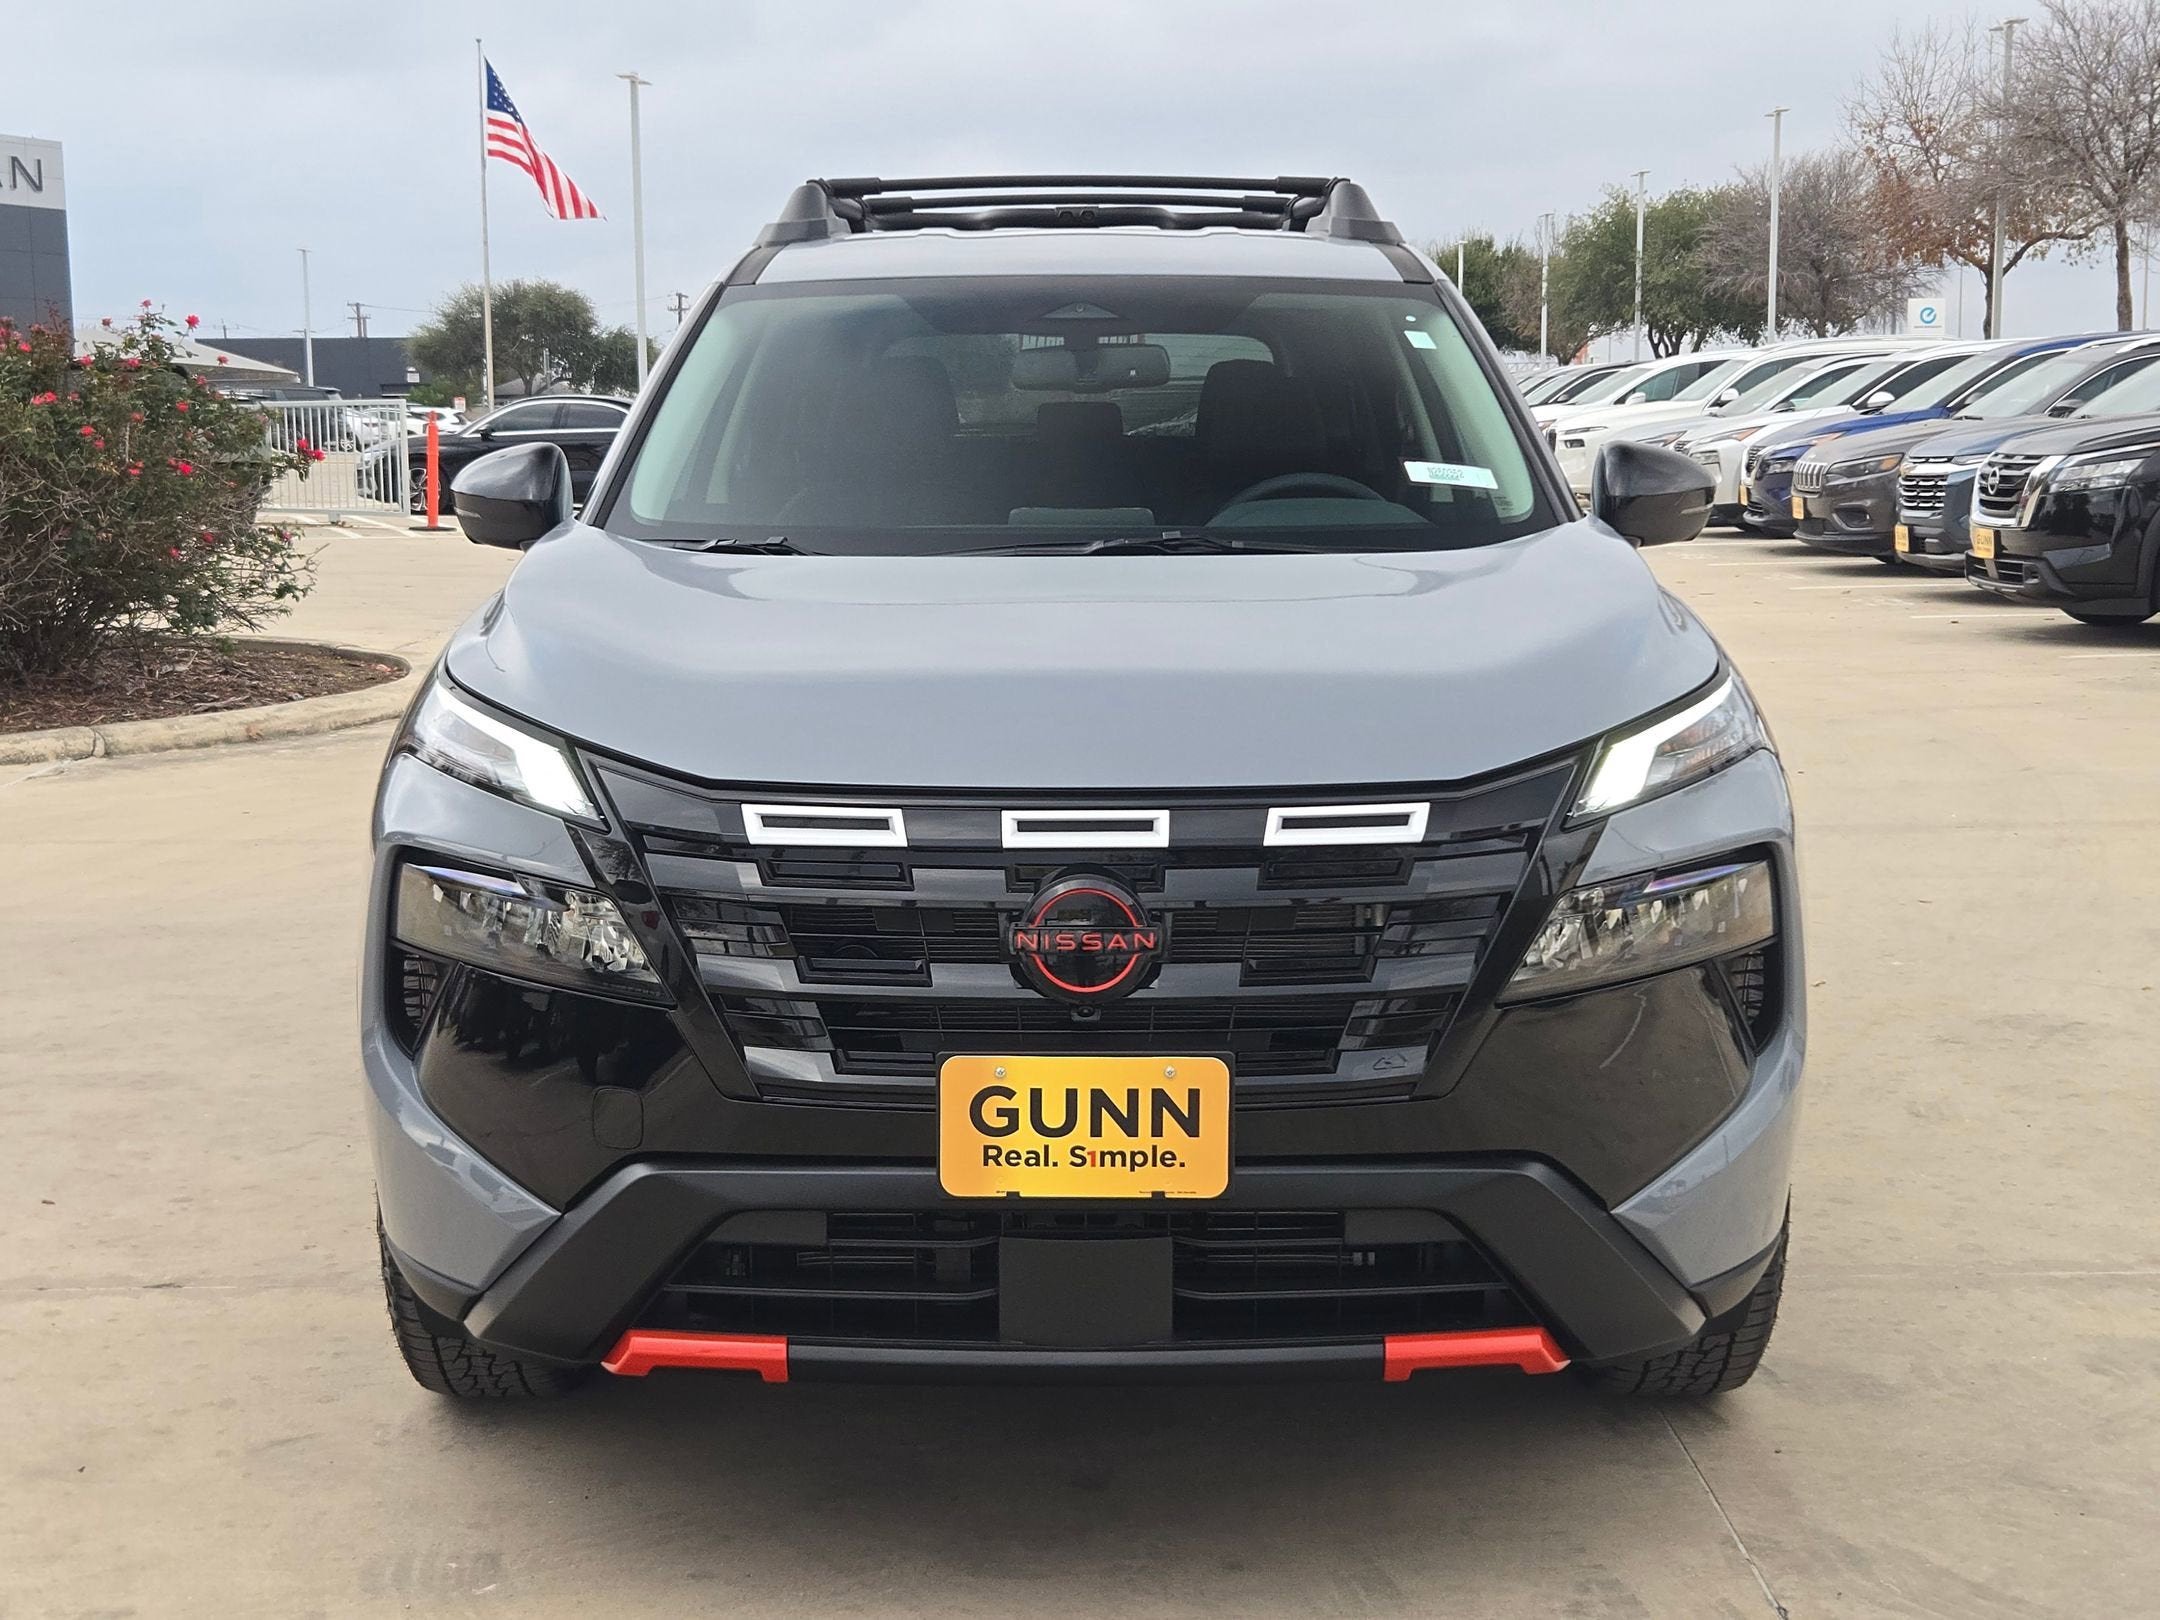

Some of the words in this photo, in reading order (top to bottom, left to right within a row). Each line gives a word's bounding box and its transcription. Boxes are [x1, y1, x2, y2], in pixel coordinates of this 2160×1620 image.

[0, 155, 44, 193] N
[1015, 931, 1156, 951] NISSAN
[968, 1085, 1200, 1138] GUNN
[982, 1144, 1058, 1168] Real.
